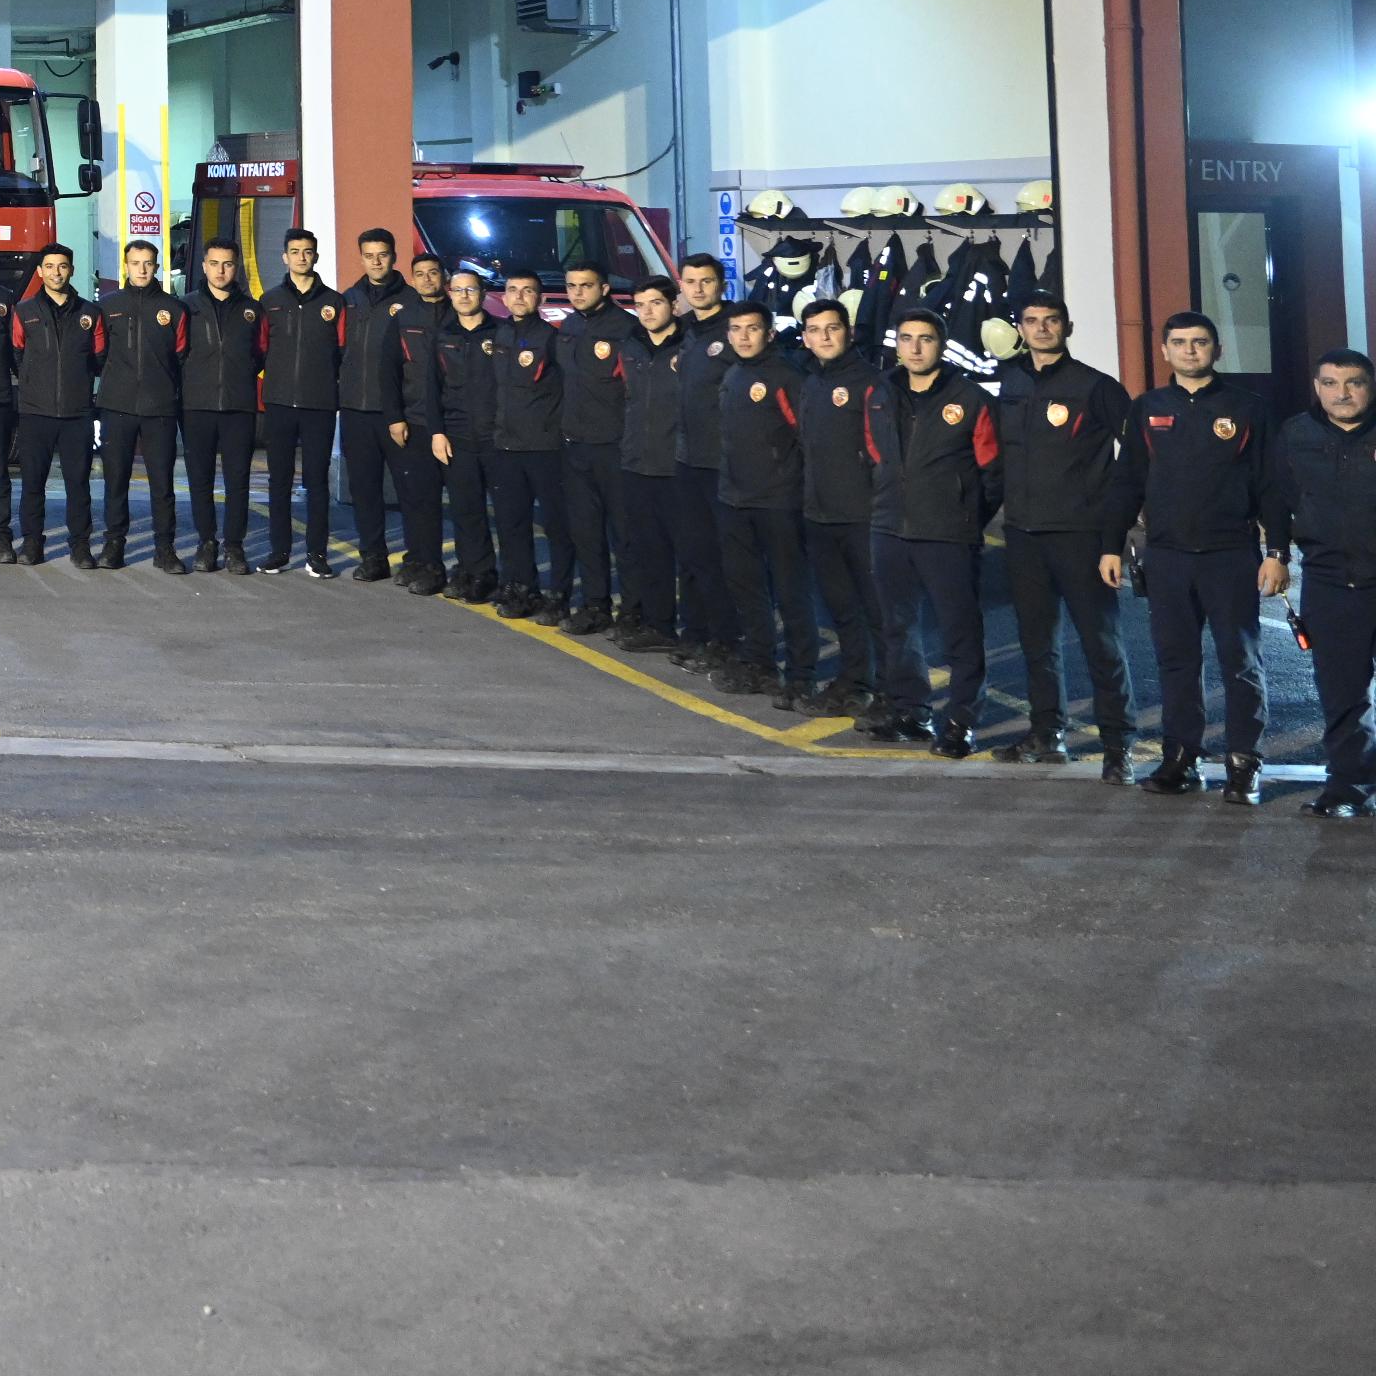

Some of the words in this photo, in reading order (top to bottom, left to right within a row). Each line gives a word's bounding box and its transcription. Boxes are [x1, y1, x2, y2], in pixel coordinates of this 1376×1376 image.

[207, 164, 237, 178] KONYA
[239, 162, 285, 178] İTFAİYESİ
[1201, 160, 1283, 183] ENTRY
[130, 214, 159, 224] SİGARA
[130, 224, 160, 233] İÇİLMEZ
